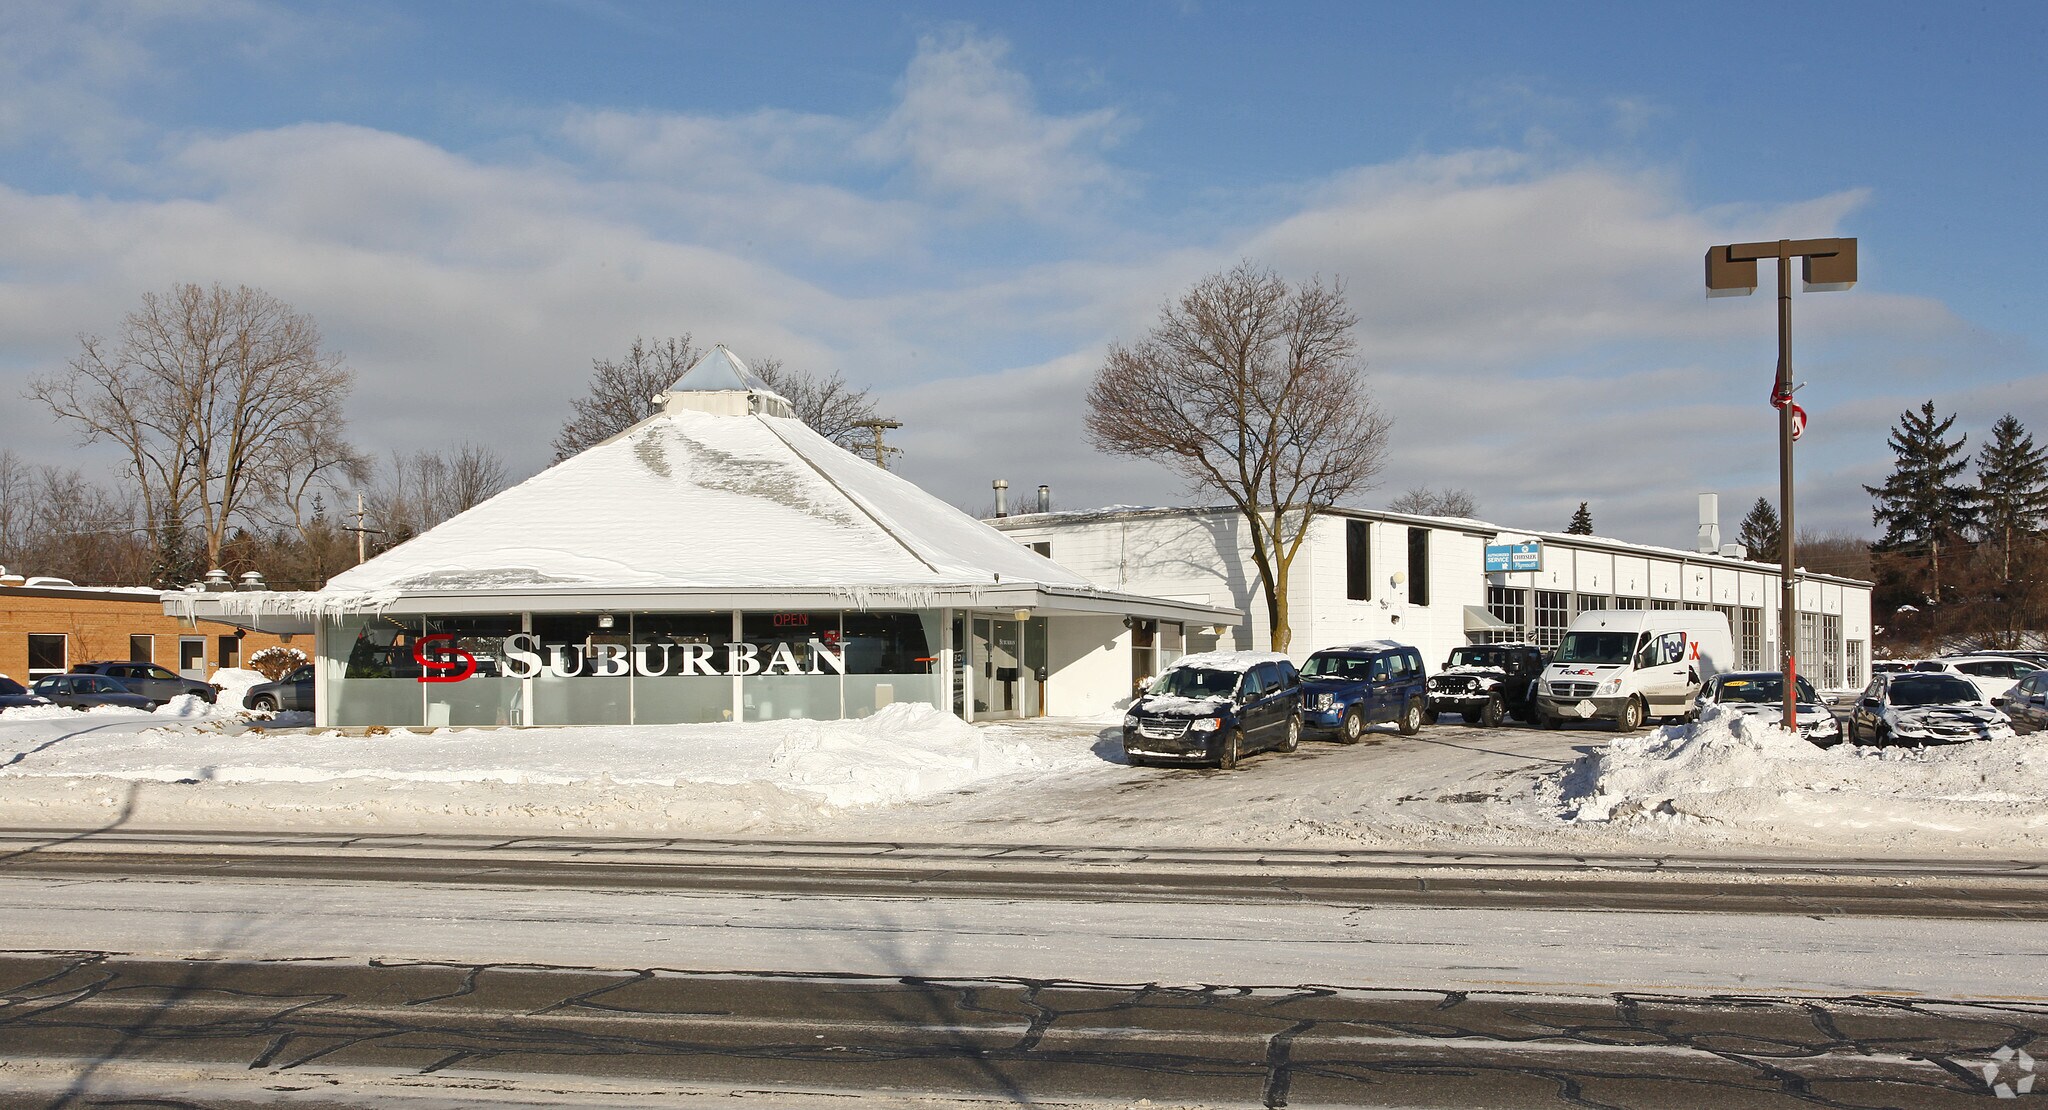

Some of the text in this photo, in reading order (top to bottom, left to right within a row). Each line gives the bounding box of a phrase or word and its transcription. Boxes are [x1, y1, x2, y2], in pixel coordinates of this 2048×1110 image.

[773, 613, 808, 626] OPEN
[501, 632, 852, 678] SUBURBAN
[1559, 668, 1595, 676] FedEx
